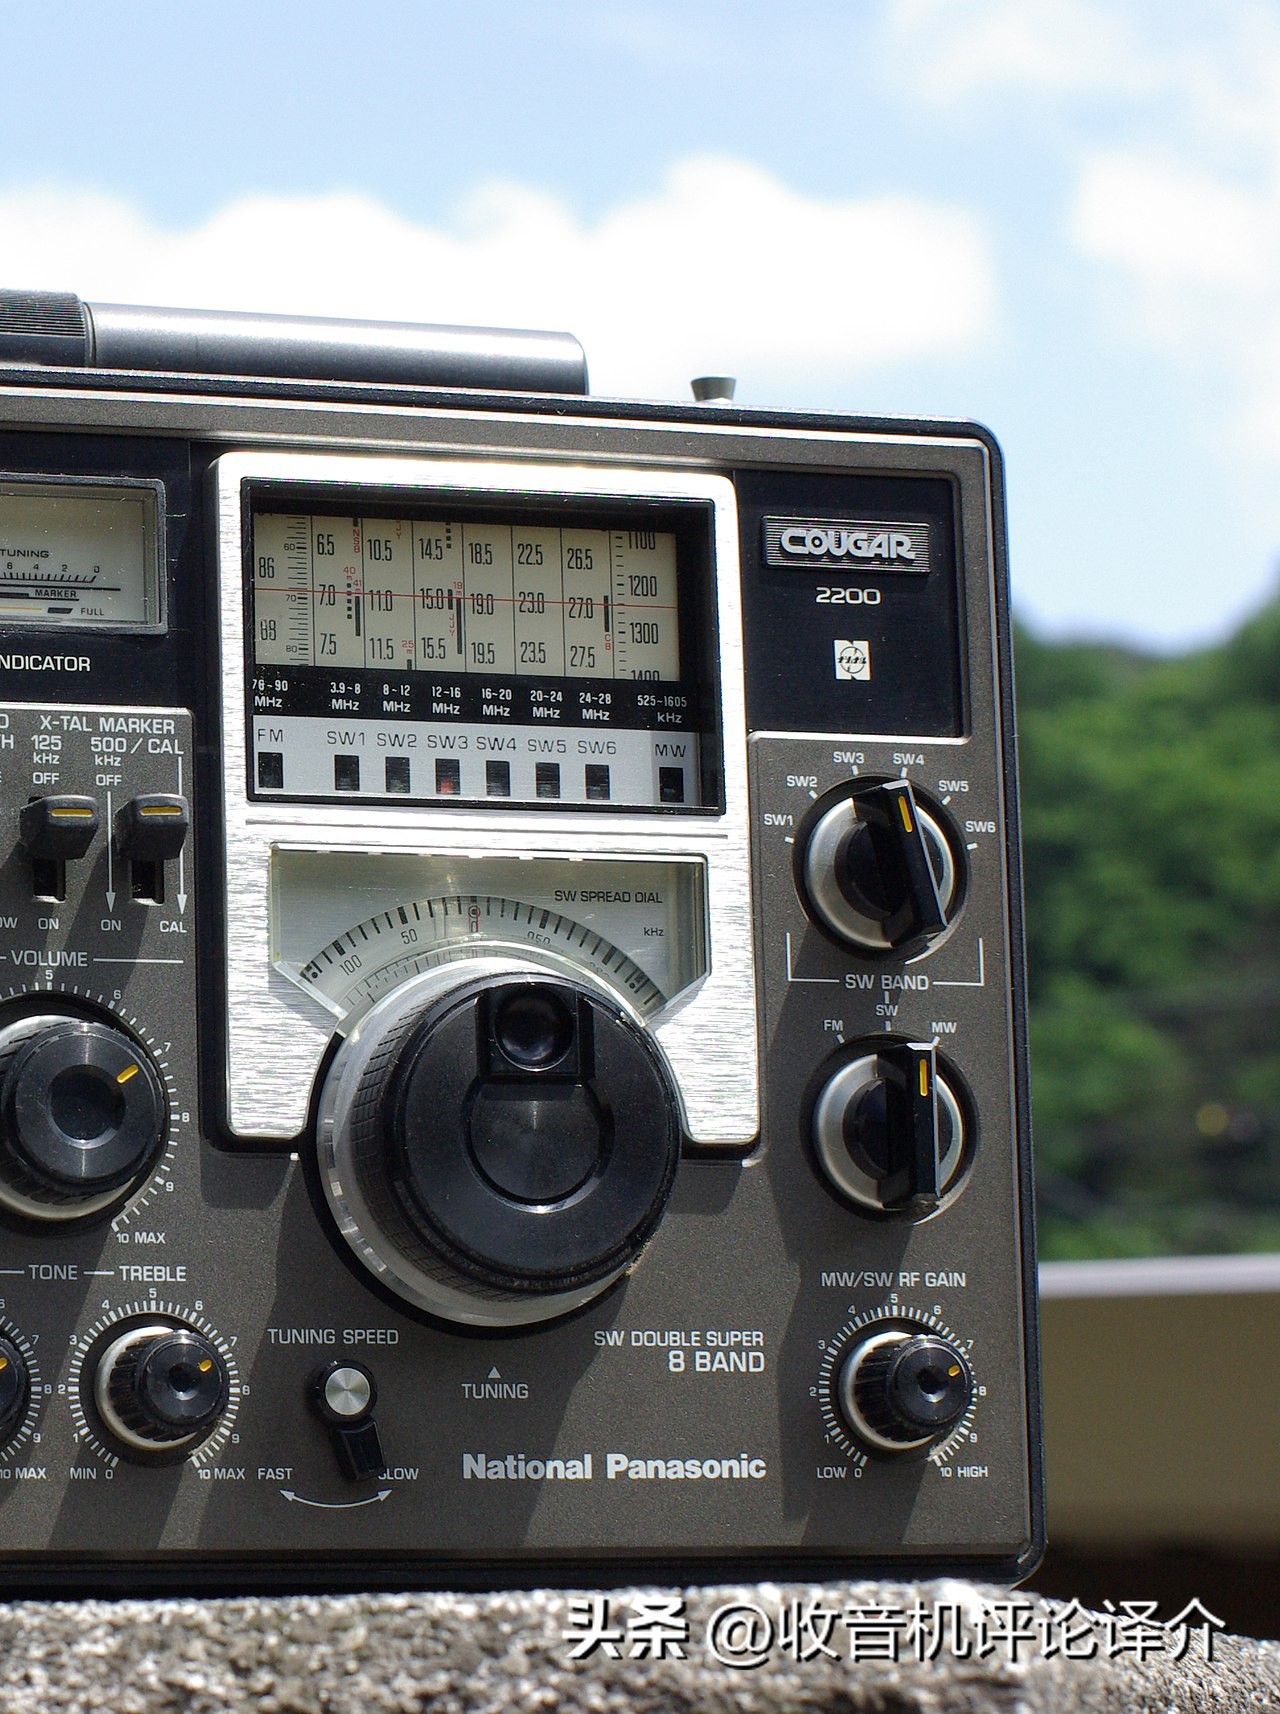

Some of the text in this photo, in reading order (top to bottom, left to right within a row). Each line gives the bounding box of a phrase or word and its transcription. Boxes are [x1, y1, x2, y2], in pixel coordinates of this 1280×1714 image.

[284, 543, 295, 551] 60
[317, 534, 335, 556] 6.5
[368, 539, 392, 561] 10.5
[419, 538, 443, 560] 14.5
[781, 528, 916, 559] COUGAR
[469, 543, 493, 565] 18.5
[517, 543, 543, 566] 22.5
[567, 548, 593, 570] 26.5
[7, 562, 13, 570] 6
[33, 563, 39, 571] 4
[62, 564, 68, 572] 2
[258, 556, 275, 578] 86
[628, 575, 657, 597] 1200
[34, 589, 78, 598] MARKER
[286, 594, 296, 602] 70
[319, 584, 336, 606] 7.0
[420, 588, 444, 610] 15.0
[816, 587, 881, 605] 2200
[369, 590, 393, 612] 11.0
[470, 593, 494, 615] 19.0
[519, 592, 545, 614] 23.0
[569, 597, 594, 619] 27.0
[80, 607, 105, 616] FULL
[629, 622, 659, 644] 1300
[286, 645, 297, 653] 80
[320, 633, 337, 655] 7.5
[369, 638, 394, 660] 11.5
[421, 637, 446, 659] 15.5
[471, 642, 495, 665] 19.5
[521, 642, 546, 664] 23.5
[570, 646, 595, 668] 27.5
[254, 696, 283, 708] MHz
[332, 699, 360, 711] MHz
[383, 701, 411, 713] MHz
[433, 702, 461, 715] MHz
[483, 705, 511, 717] MHz
[533, 706, 561, 719] MHz
[582, 708, 610, 721] MHz
[658, 712, 682, 724] kHz
[40, 715, 175, 734] X-TAL MARKER
[258, 729, 284, 743] FM
[327, 731, 365, 746] SW1
[377, 733, 417, 748] SW2
[427, 735, 469, 750] SW3
[31, 736, 62, 751] 125
[90, 737, 184, 755] 500 CAL
[476, 736, 517, 751] SW4
[527, 739, 567, 753] SW5
[577, 740, 617, 755] SW6
[655, 743, 687, 758] MW
[33, 752, 60, 765] kHz
[94, 754, 121, 767] kHz
[833, 751, 865, 764] SW3
[893, 753, 924, 765] SW4
[32, 772, 60, 785] OFF
[95, 774, 122, 786] OFF
[786, 776, 818, 788] SW2
[938, 781, 969, 792] SW5
[763, 815, 794, 827] SW1
[965, 821, 996, 833] SW6
[554, 890, 663, 904] SW SPREAD DIAL
[38, 918, 59, 931] ON
[101, 919, 121, 932] ON
[159, 921, 188, 934] CAL
[400, 928, 418, 945] 50
[644, 927, 664, 937] kHz
[11, 950, 88, 967] VOLUME
[339, 954, 363, 976] 100
[45, 970, 53, 979] 5
[845, 974, 929, 990] SW BAND
[114, 990, 121, 999] 6
[875, 1004, 898, 1017] SW
[823, 1020, 843, 1031] FM
[931, 1022, 957, 1034] MW
[163, 1042, 171, 1052] 7
[182, 1113, 190, 1122] 8
[165, 1182, 174, 1191] 9
[116, 1232, 166, 1244] 10 MAX
[28, 1264, 78, 1280] TONE
[119, 1265, 186, 1281] TREBLE
[821, 1271, 966, 1288] MW/SW RF GAIN
[267, 1329, 399, 1346] TUNING SPEED
[594, 1330, 764, 1347] SW DOUBLE SUPER
[668, 1351, 765, 1373] 8 BAND
[462, 1383, 529, 1399] TUNING
[70, 1467, 113, 1480] MIN 0
[463, 1453, 767, 1480] National Panasonic
[817, 1467, 862, 1478] LOW 0
[939, 1467, 989, 1478] 10 HIGH
[15, 1468, 47, 1480] MAX
[197, 1468, 245, 1480] 10 MAX
[258, 1467, 293, 1481] FAST
